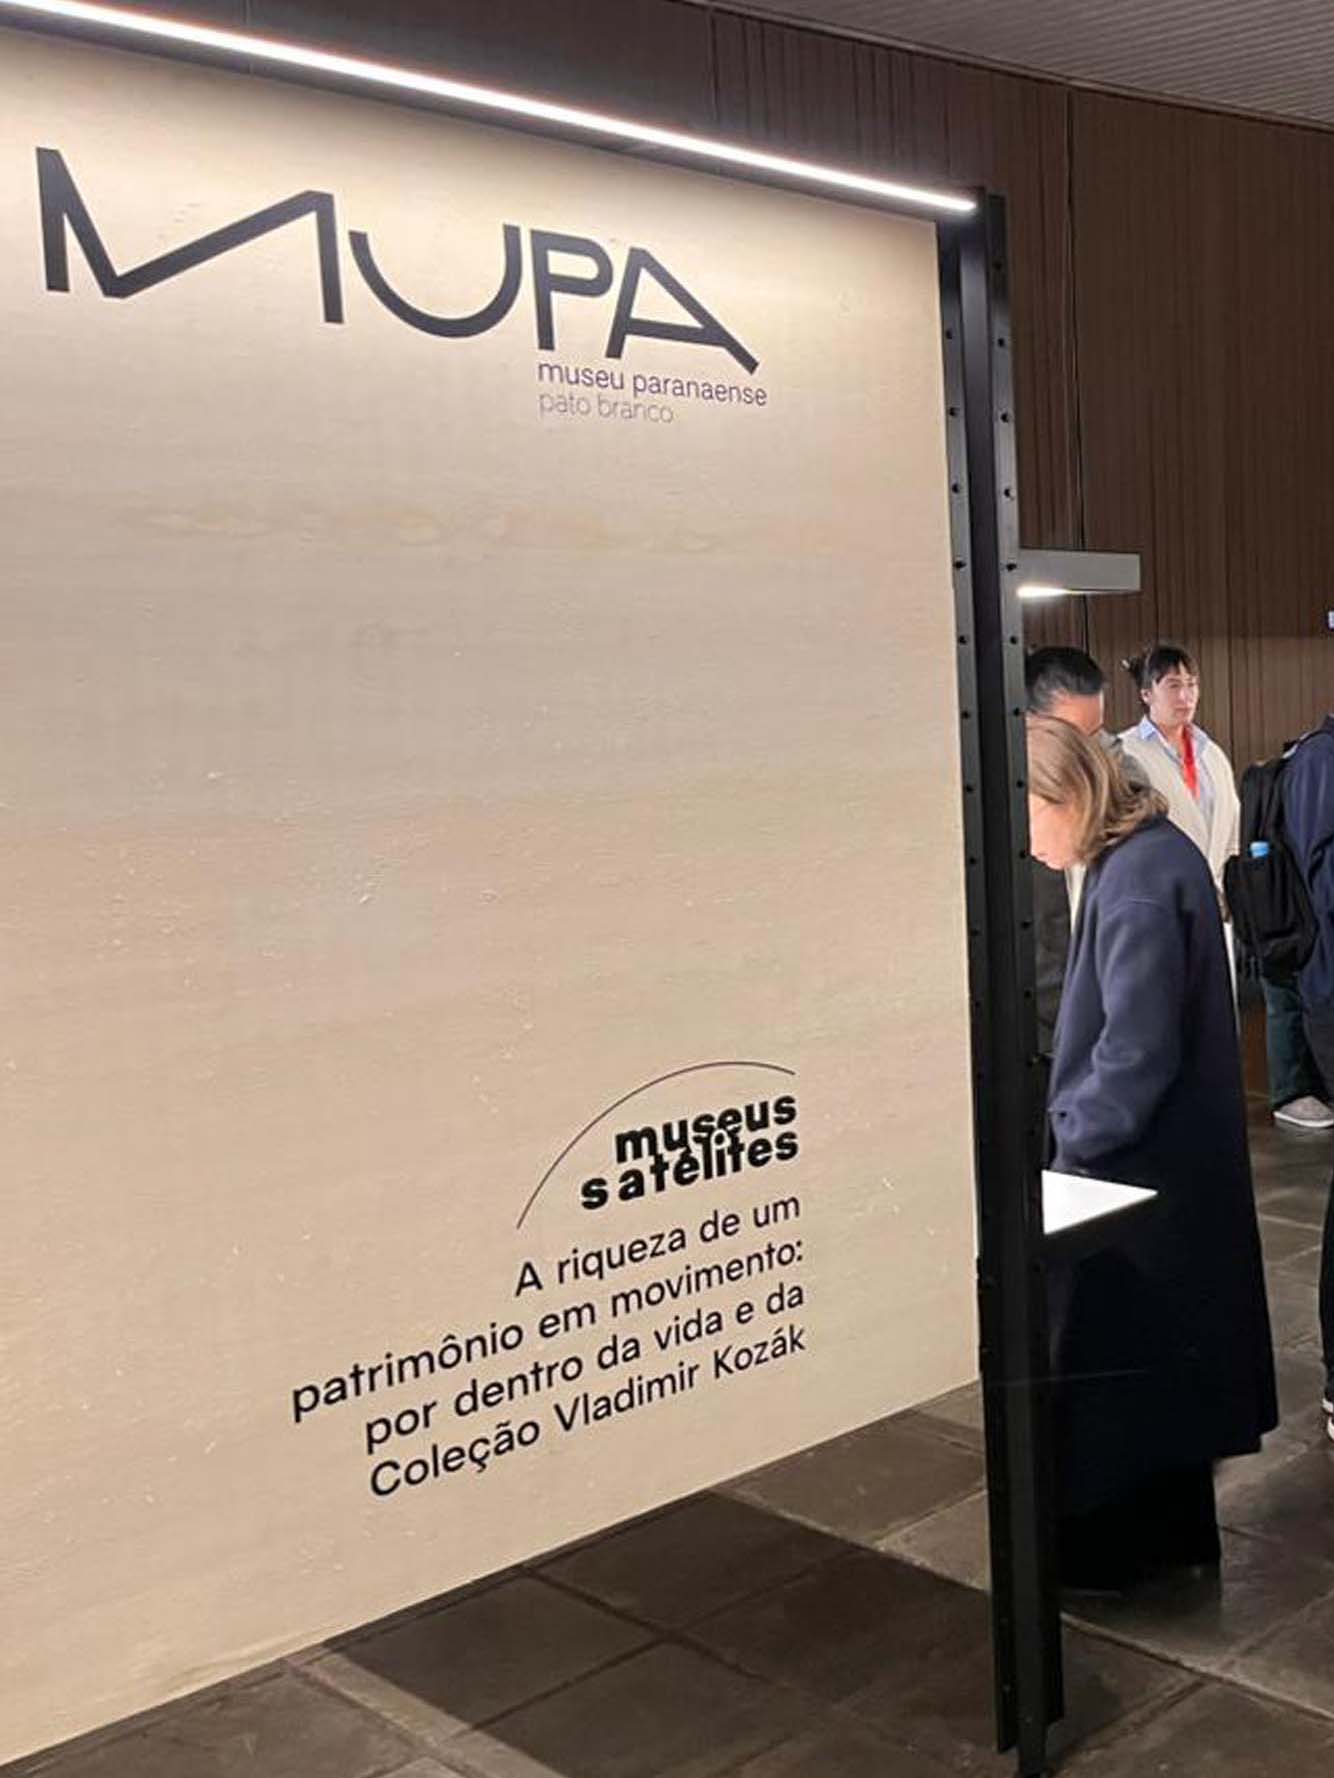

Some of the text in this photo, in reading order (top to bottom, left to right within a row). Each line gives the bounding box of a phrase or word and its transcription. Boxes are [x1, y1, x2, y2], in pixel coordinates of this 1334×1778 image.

[36, 147, 759, 375] MUPA
[537, 360, 767, 408] museu paranaense
[538, 390, 674, 424] pato branco
[581, 1130, 799, 1210] satélites
[614, 1095, 797, 1165] museus
[515, 1195, 801, 1297] A riqueza de um
[292, 1239, 804, 1423] patrimônio em movimento:
[365, 1283, 804, 1455] por dentro da vida e da
[369, 1326, 806, 1498] Coleção Vladimir Kozák
